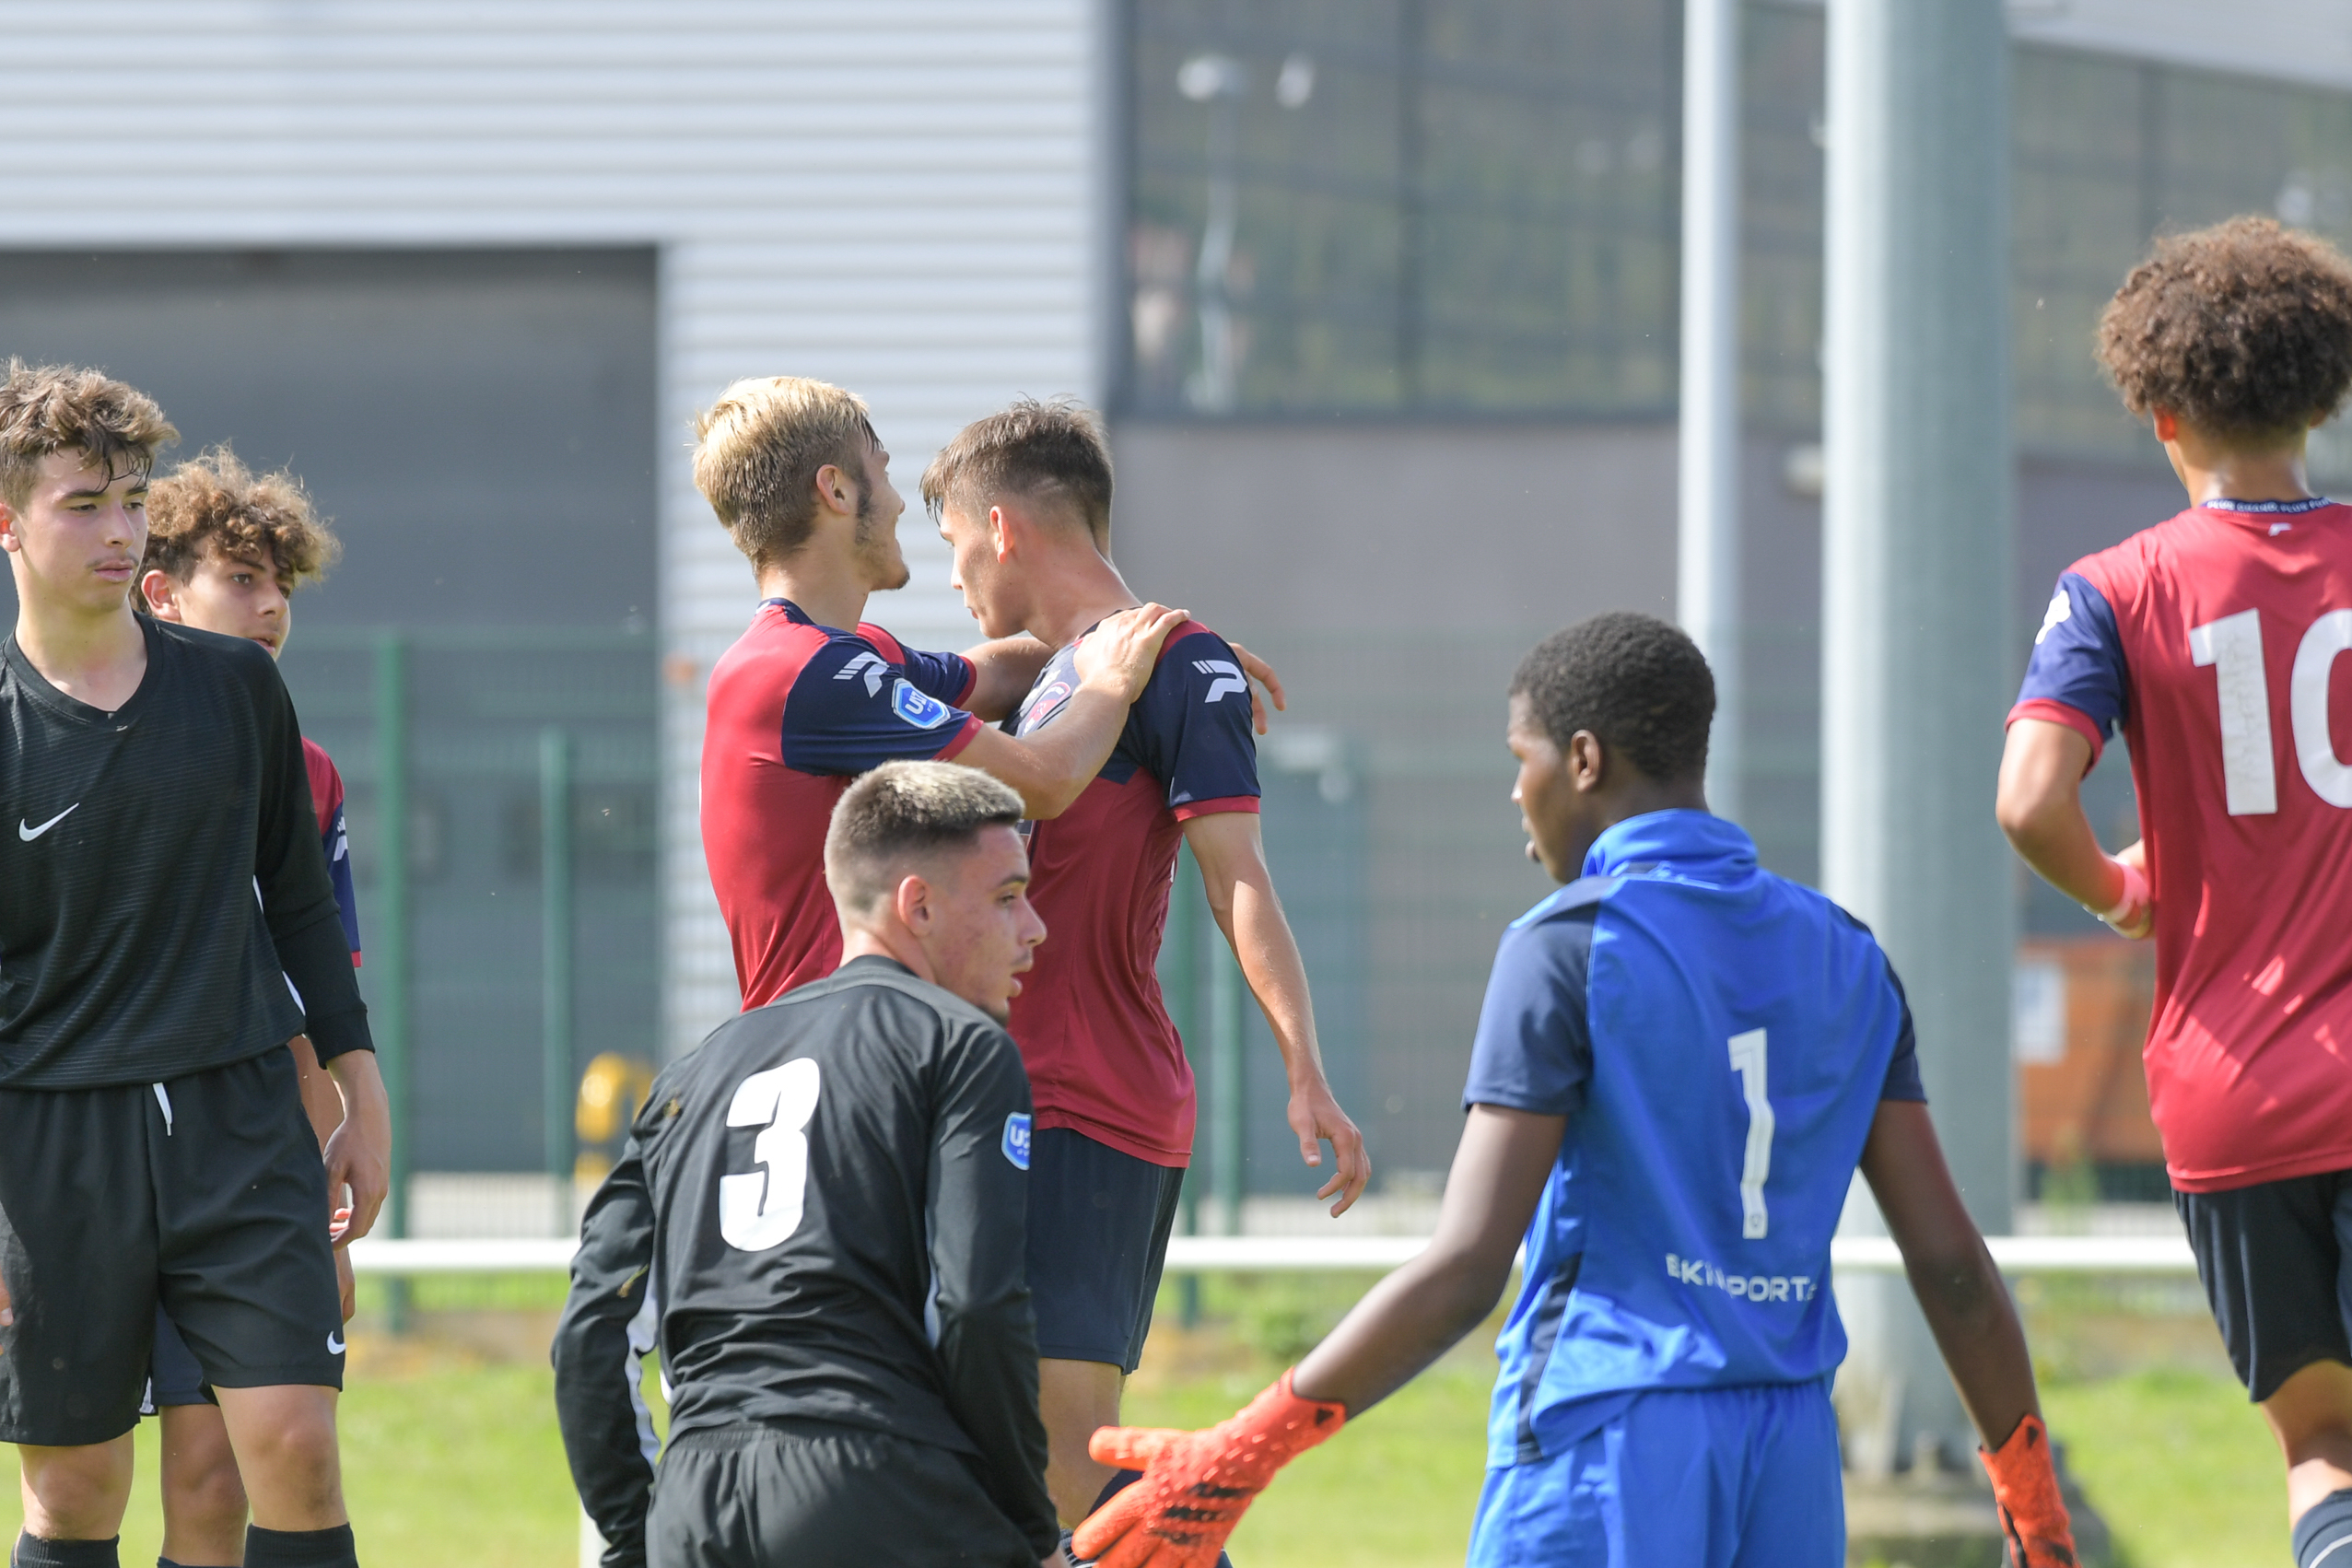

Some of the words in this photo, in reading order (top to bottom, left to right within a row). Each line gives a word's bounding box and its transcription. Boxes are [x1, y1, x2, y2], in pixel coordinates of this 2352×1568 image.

[2188, 607, 2352, 816] 10
[719, 1058, 821, 1252] 3
[1727, 1026, 1775, 1240] 1
